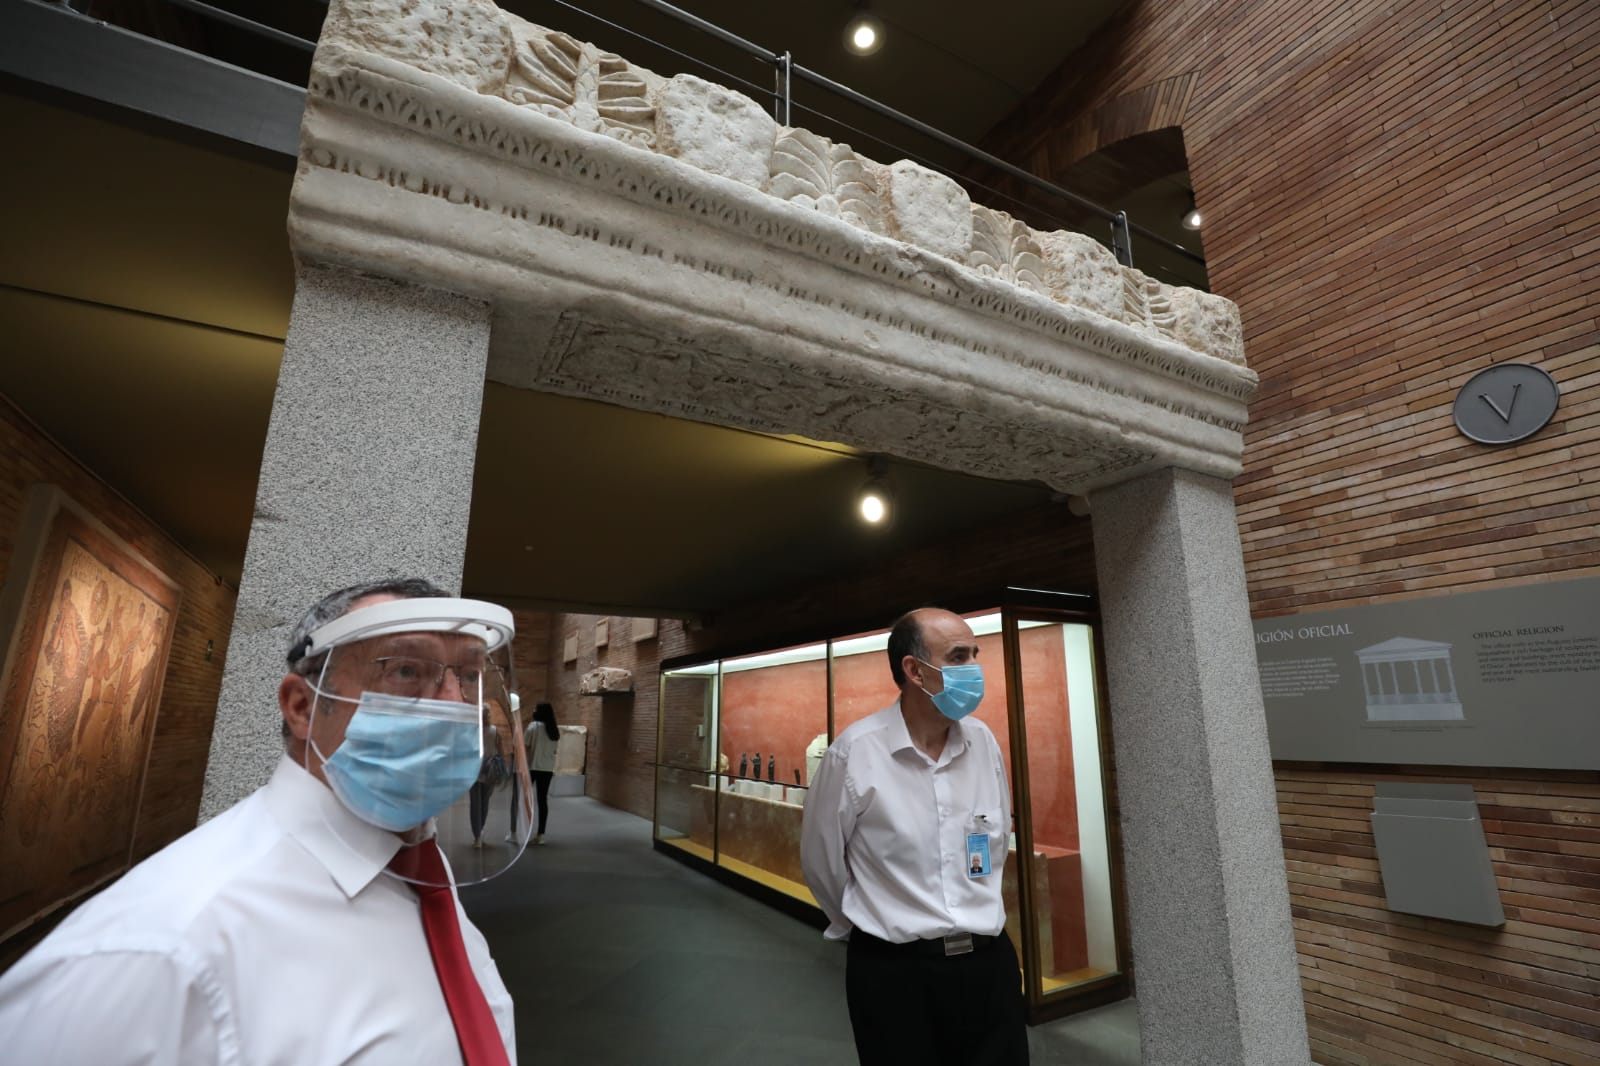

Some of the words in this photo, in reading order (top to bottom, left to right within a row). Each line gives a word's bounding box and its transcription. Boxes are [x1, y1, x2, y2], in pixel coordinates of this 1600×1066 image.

[1478, 384, 1521, 424] V
[1255, 629, 1294, 643] IGIÓN
[1298, 624, 1352, 639] OFICIAL
[1473, 630, 1512, 639] OFFICIAL
[1516, 625, 1565, 636] RELIGION
